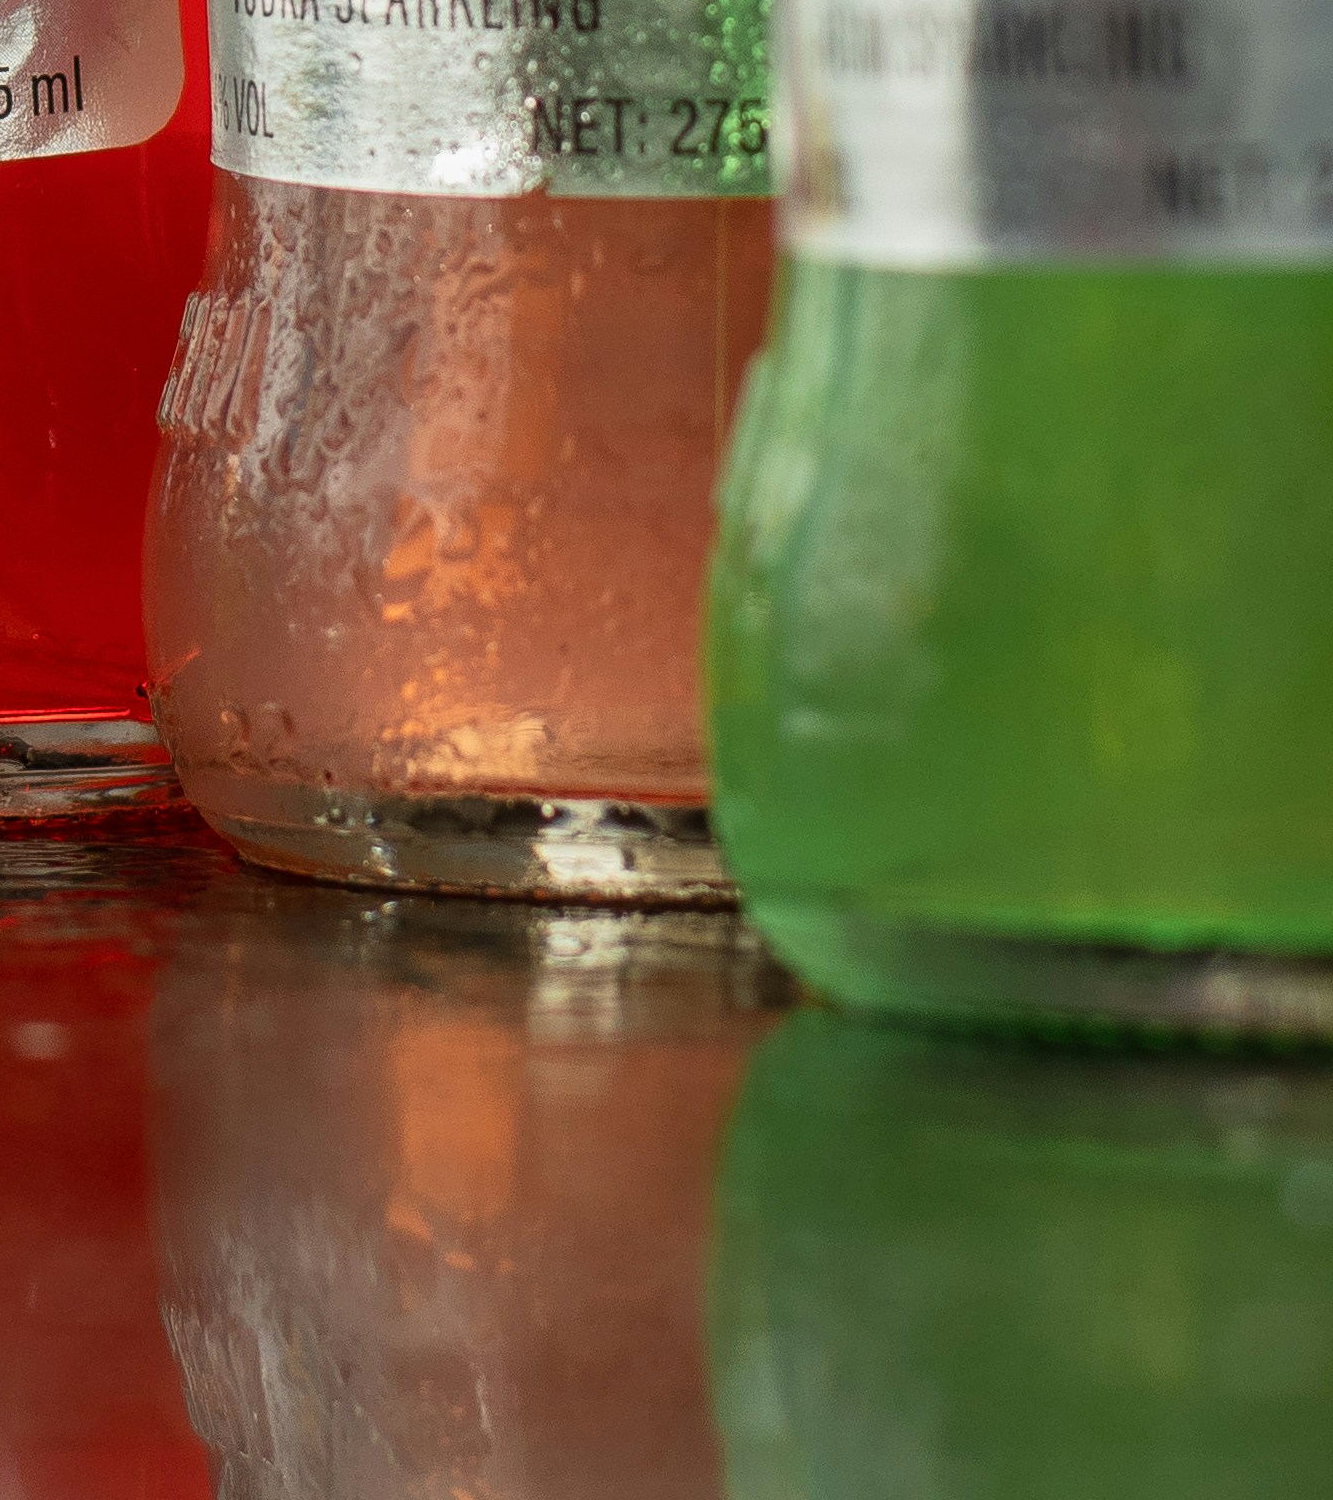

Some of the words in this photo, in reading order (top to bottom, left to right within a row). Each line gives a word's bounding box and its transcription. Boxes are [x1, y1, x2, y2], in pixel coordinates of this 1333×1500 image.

[32, 54, 85, 117] ml
[233, 74, 274, 138] VOL
[532, 98, 648, 155] NET:
[666, 98, 770, 156] 275
